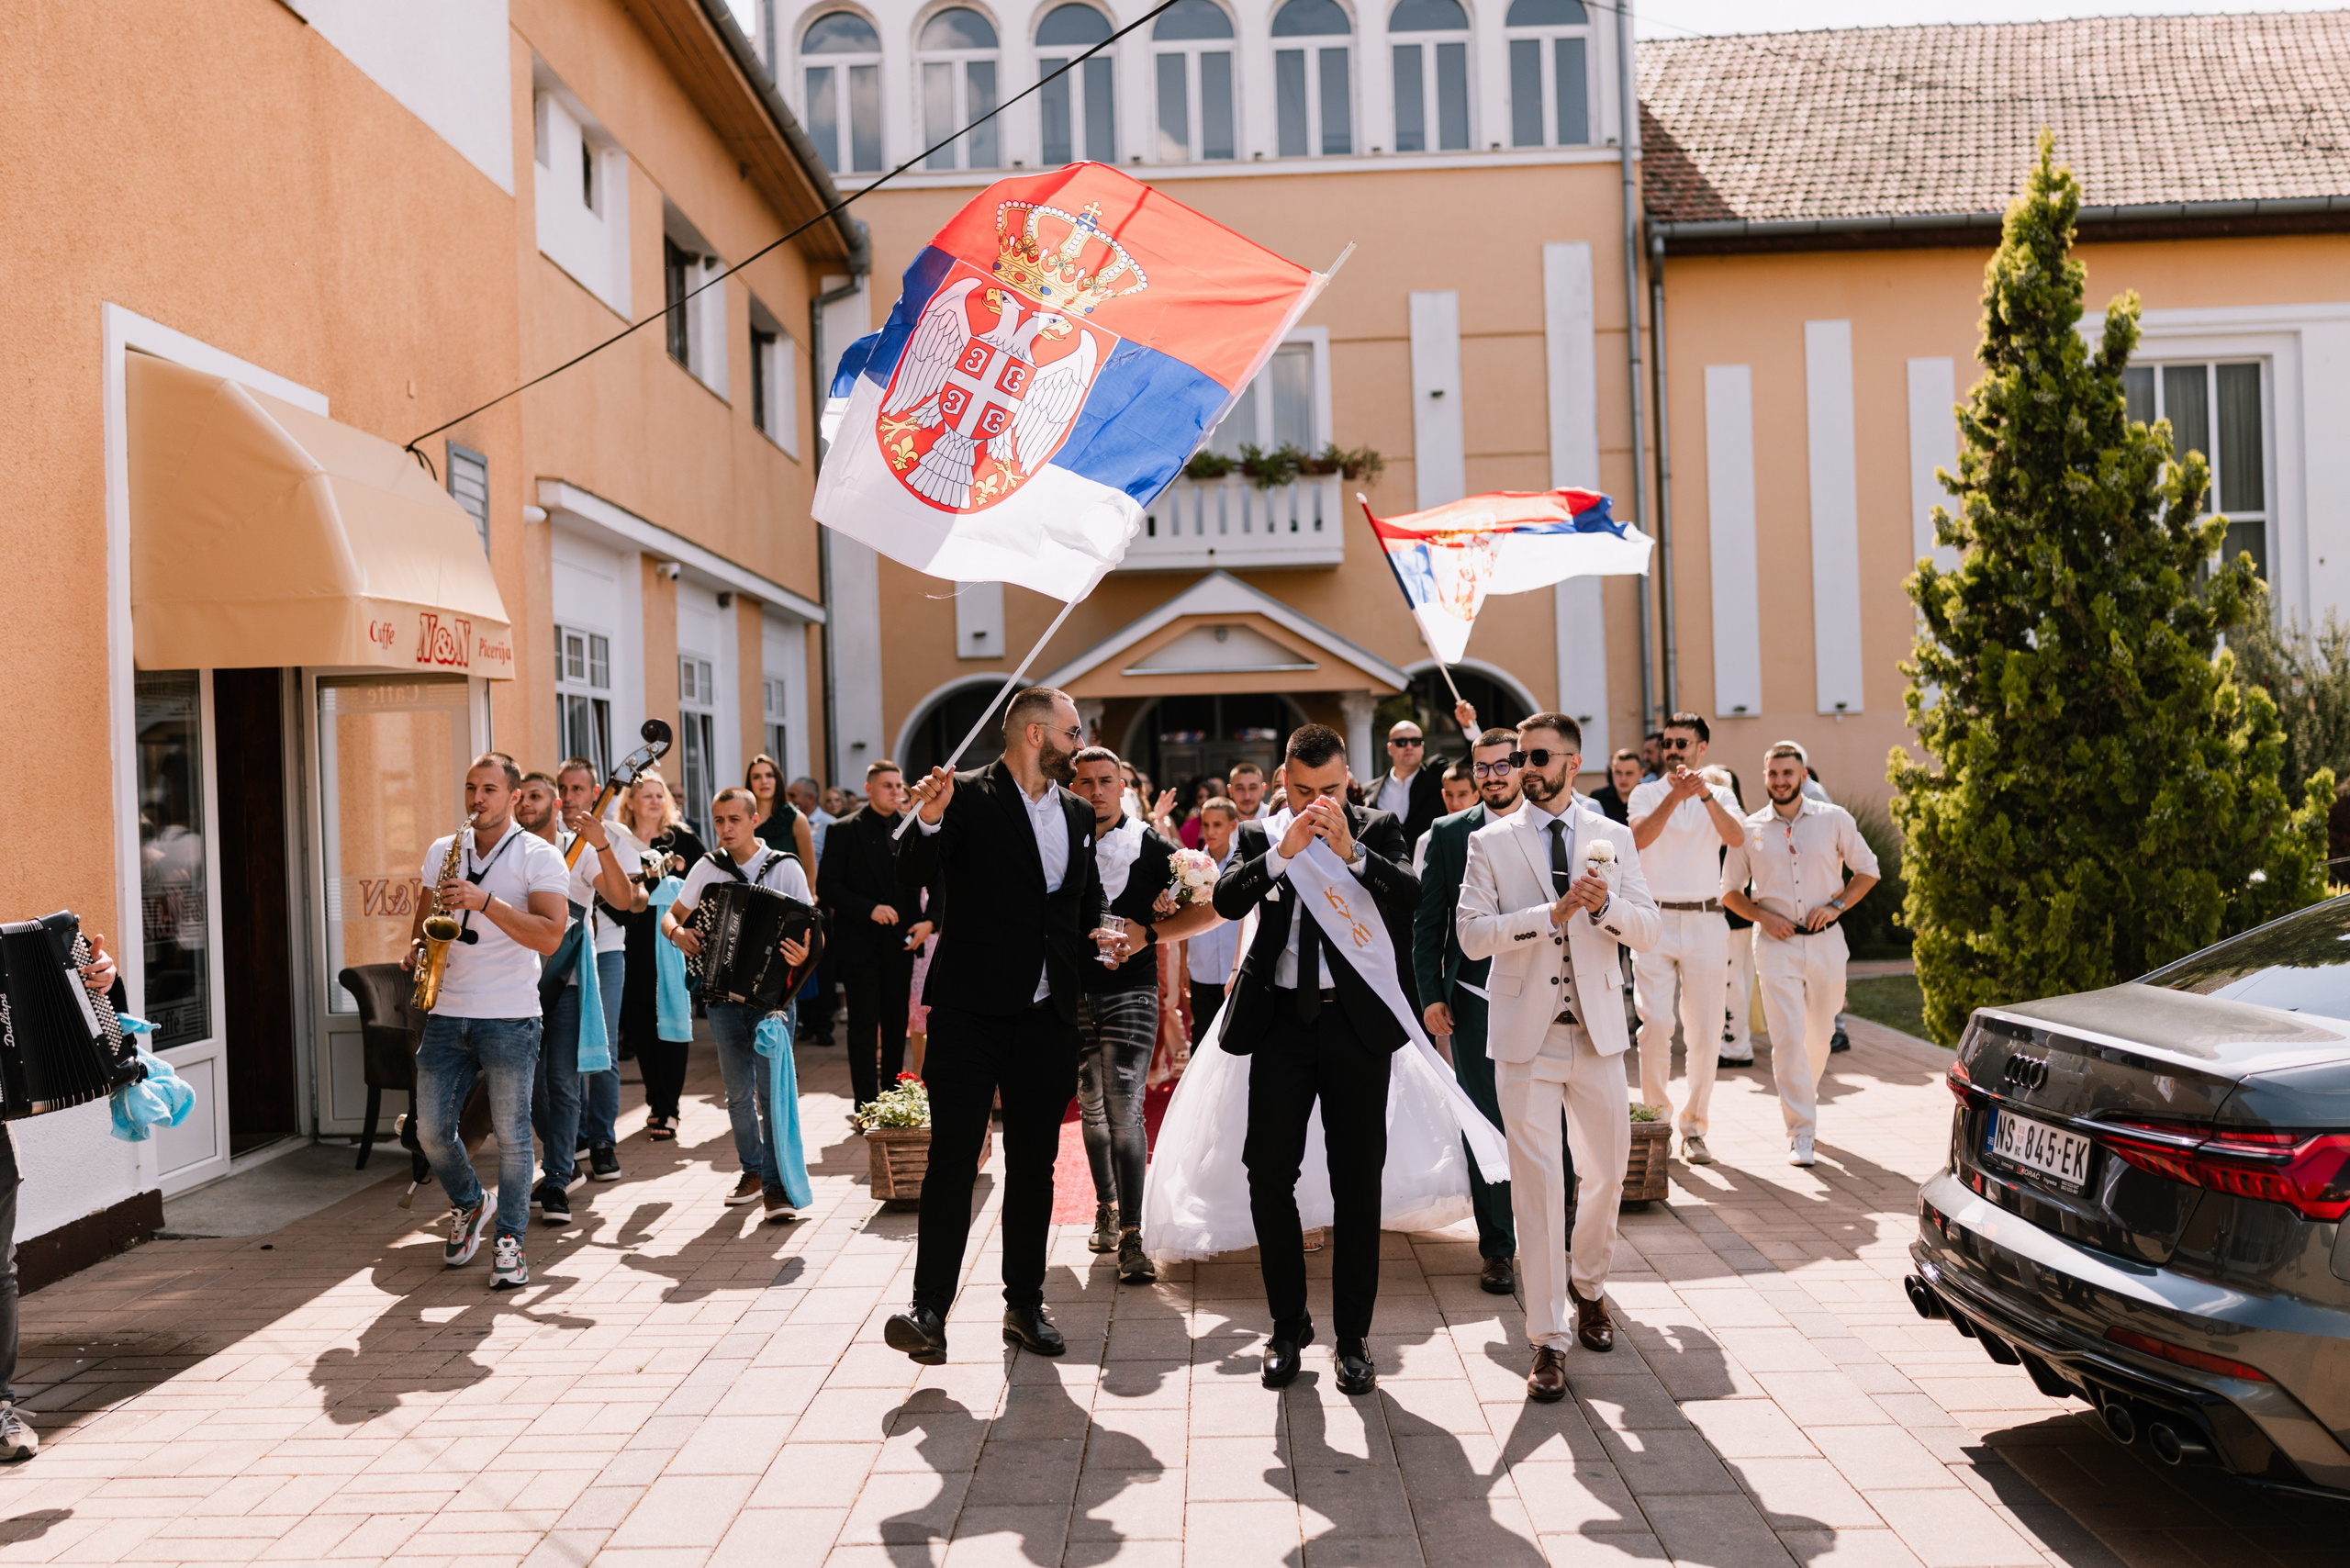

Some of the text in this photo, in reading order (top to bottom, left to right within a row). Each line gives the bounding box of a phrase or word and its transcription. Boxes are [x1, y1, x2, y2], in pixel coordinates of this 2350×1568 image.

[370, 612, 512, 667] Caffe N&N Picerija
[1996, 1114, 2016, 1153] NS
